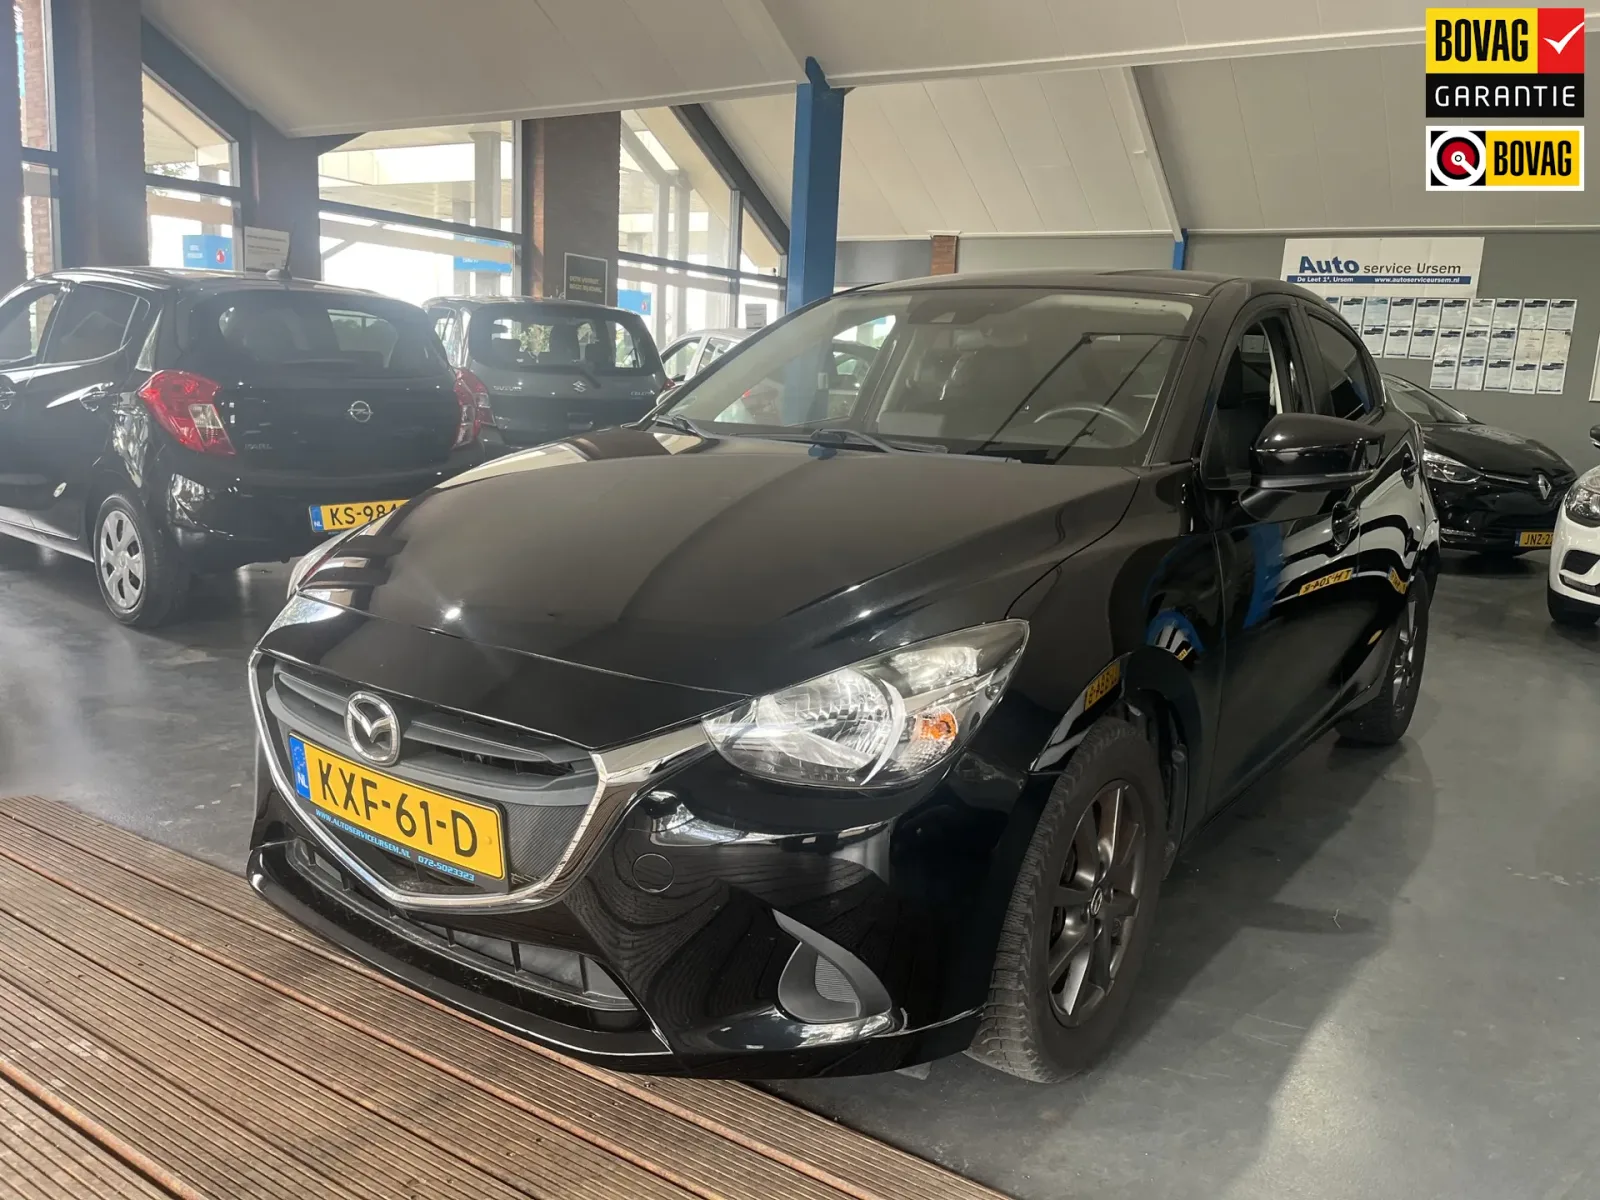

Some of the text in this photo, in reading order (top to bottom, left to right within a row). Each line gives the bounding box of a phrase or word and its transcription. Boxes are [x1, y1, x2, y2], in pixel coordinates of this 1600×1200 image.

[1299, 255, 1462, 274] Auto service Ursem
[1374, 276, 1460, 284] www.autoserviceursem.nl
[318, 758, 478, 858] KXF-61-D
[315, 808, 476, 882] WWW.AUTOSERVICEURSEM.NL 072-5023323
